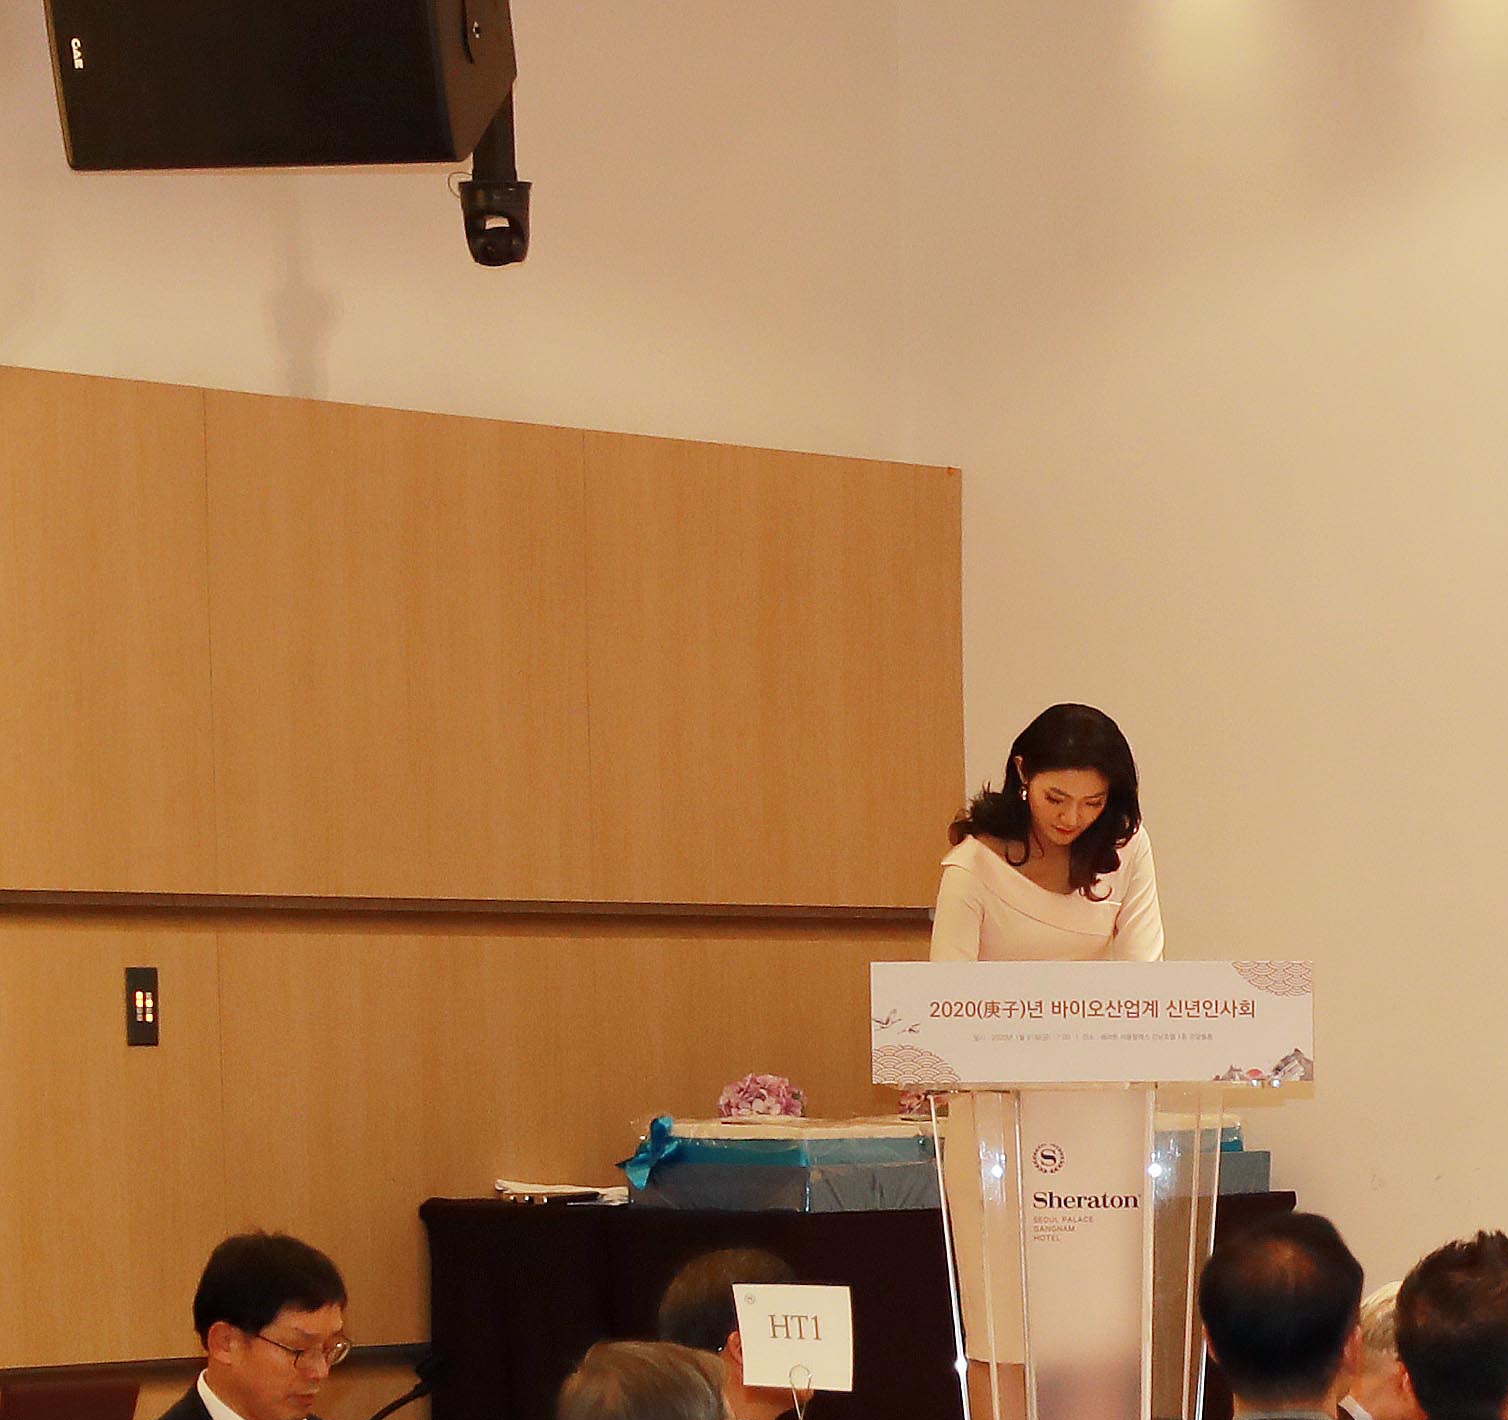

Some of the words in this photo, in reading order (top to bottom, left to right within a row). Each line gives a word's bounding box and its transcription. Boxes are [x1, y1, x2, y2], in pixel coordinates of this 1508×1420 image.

[930, 1000, 1042, 1019] 2020(庚子)년
[1052, 1000, 1158, 1018] 바이오산업계
[1167, 1000, 1254, 1018] 신년인사회
[1033, 1191, 1139, 1209] Sheraton
[768, 1314, 822, 1341] HT1
